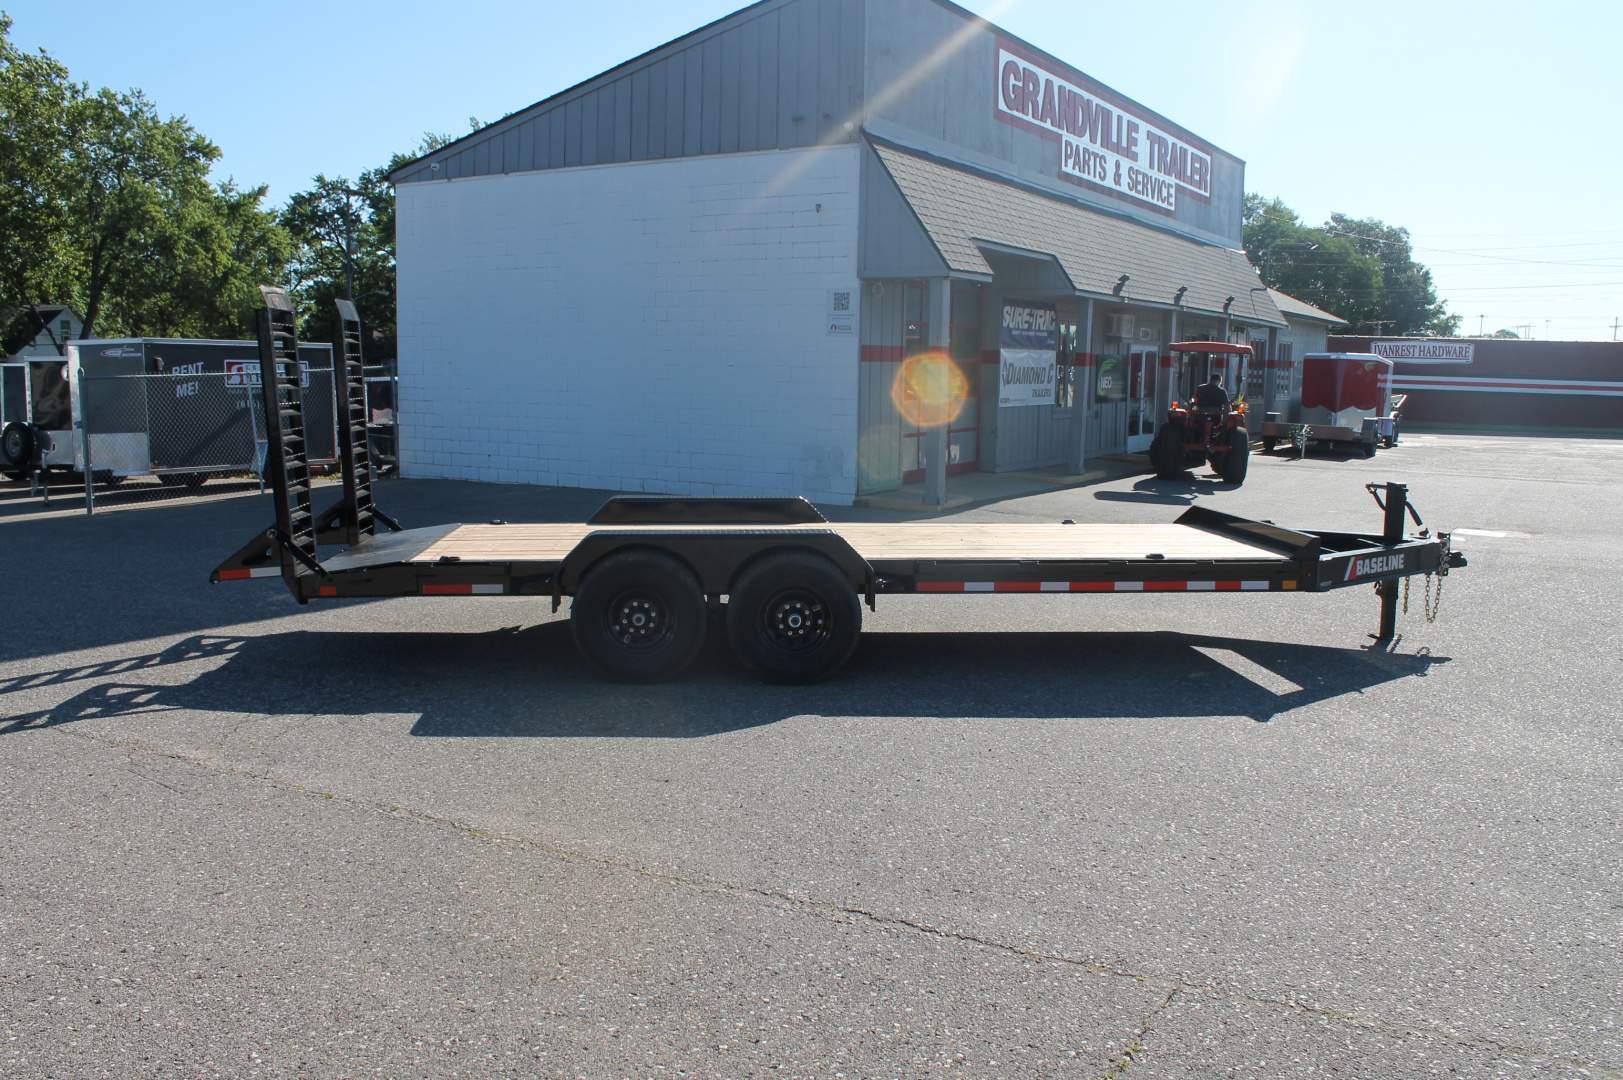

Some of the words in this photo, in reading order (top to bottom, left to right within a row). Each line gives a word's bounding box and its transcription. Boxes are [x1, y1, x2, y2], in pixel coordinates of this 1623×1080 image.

[1001, 60, 1140, 162] GRANDVILLE
[1146, 130, 1210, 193] TRAILER
[1064, 140, 1107, 182] PARTS
[1113, 159, 1122, 187] &
[1127, 166, 1174, 207] SERVICE
[1002, 305, 1056, 331] SURE-TRAC
[1419, 345, 1471, 358] HARDWARE
[1006, 362, 1046, 385] DIAMOND
[1047, 363, 1054, 385] C
[1101, 376, 1112, 389] NEO
[176, 381, 199, 398] ME!
[1356, 553, 1405, 576] BASELINE
